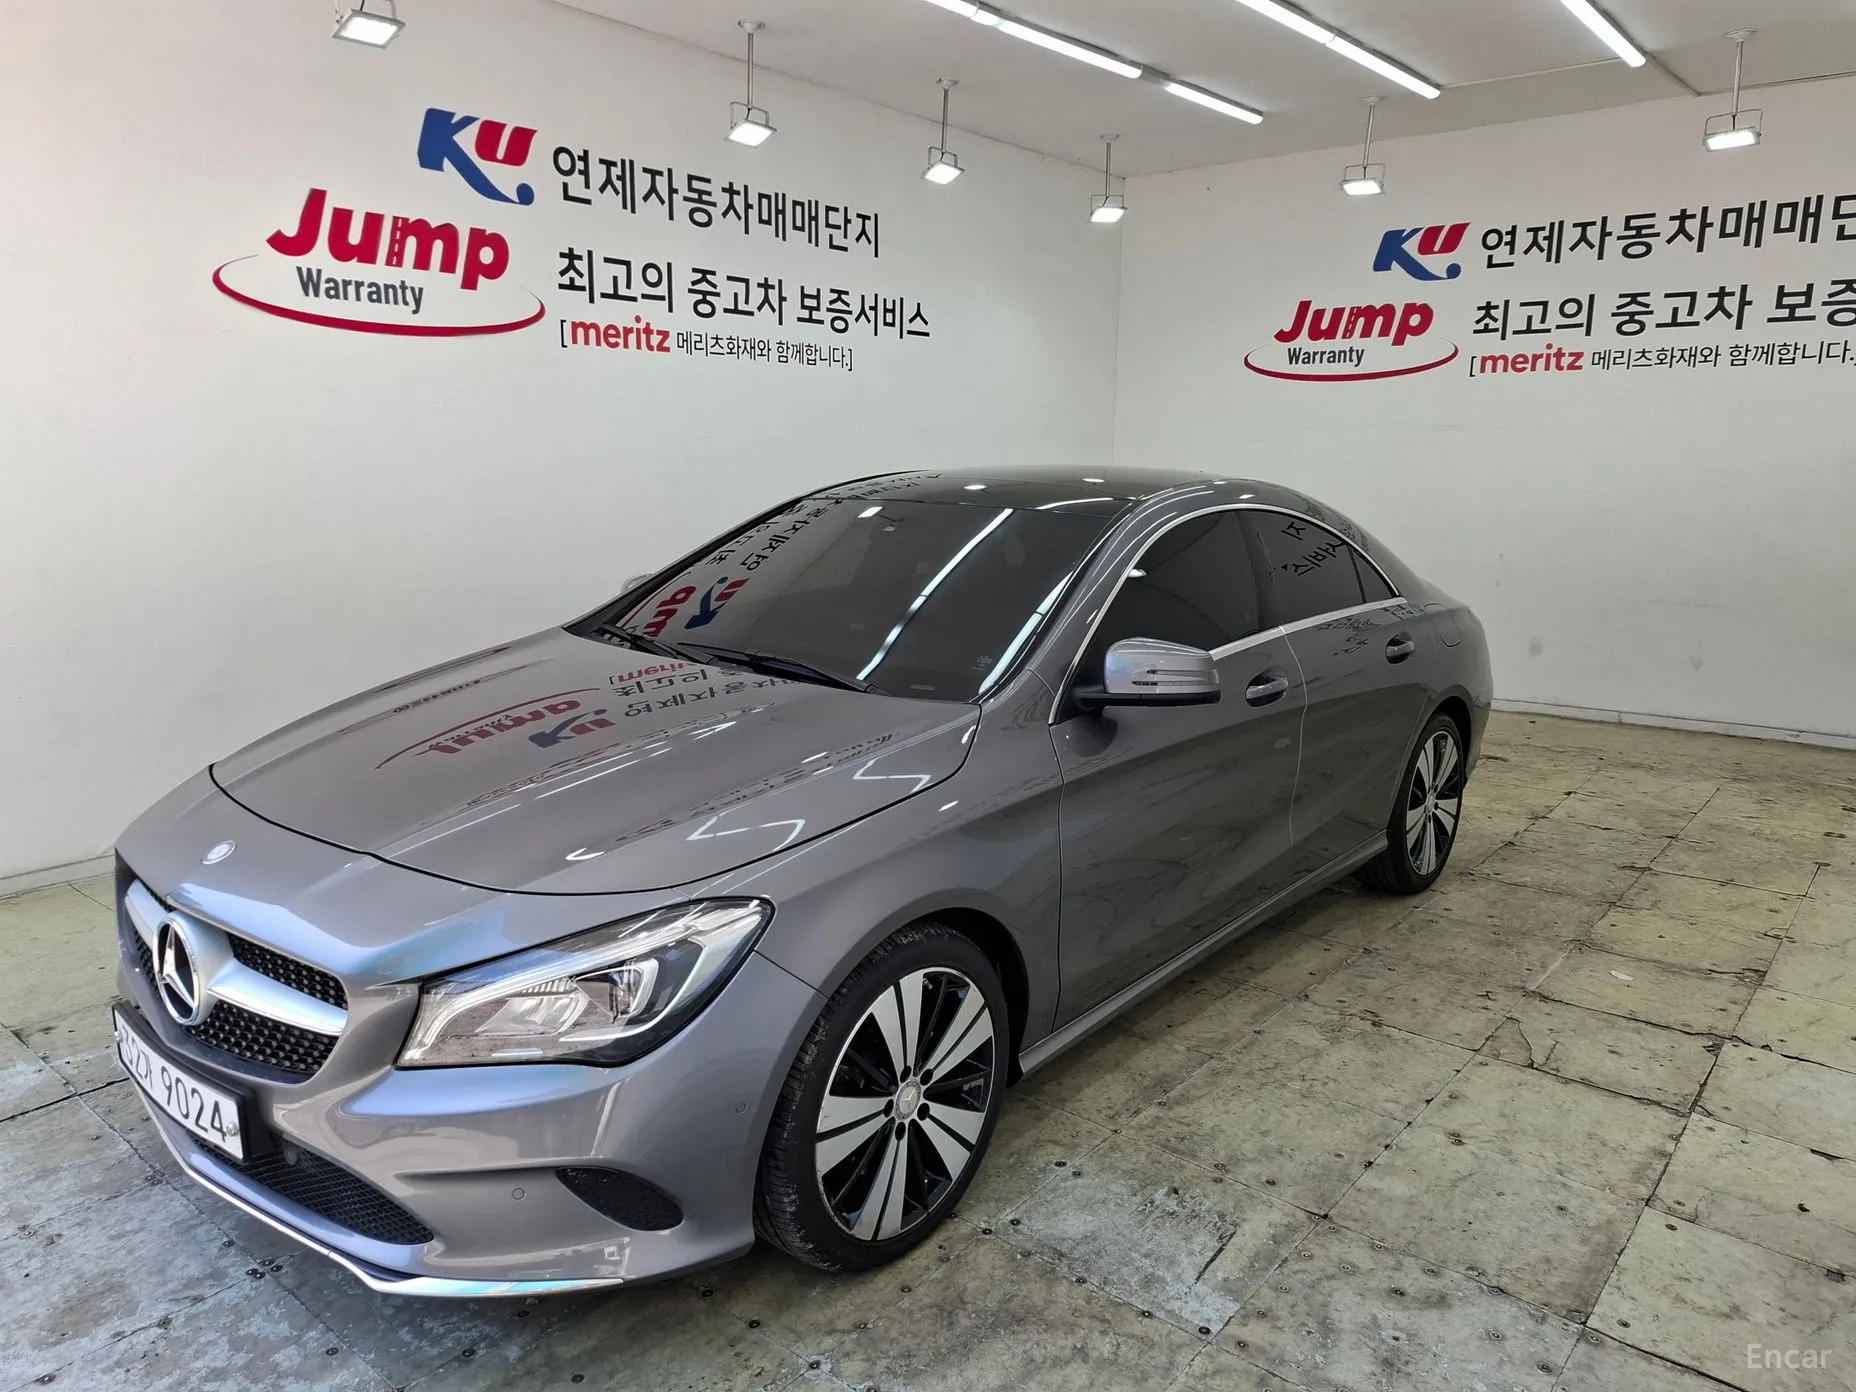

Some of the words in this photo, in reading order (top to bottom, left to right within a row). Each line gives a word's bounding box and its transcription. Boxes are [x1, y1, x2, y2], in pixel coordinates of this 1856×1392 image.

[552, 144, 880, 259] 연제자동차매매단지
[266, 187, 510, 290] Jump
[297, 266, 424, 315] Warranty
[557, 247, 674, 312] 최고의
[687, 265, 788, 326] 중고차
[797, 289, 931, 340] 보증서비스
[1472, 293, 1594, 341] 최고의
[1611, 283, 1753, 336] 중고차
[677, 331, 772, 362] 메리츠화재와
[1273, 299, 1435, 347] Jump
[1287, 345, 1365, 368] Warranty
[1591, 345, 1721, 371] 메리츠화재와
[160, 1065, 227, 1143] 9024
